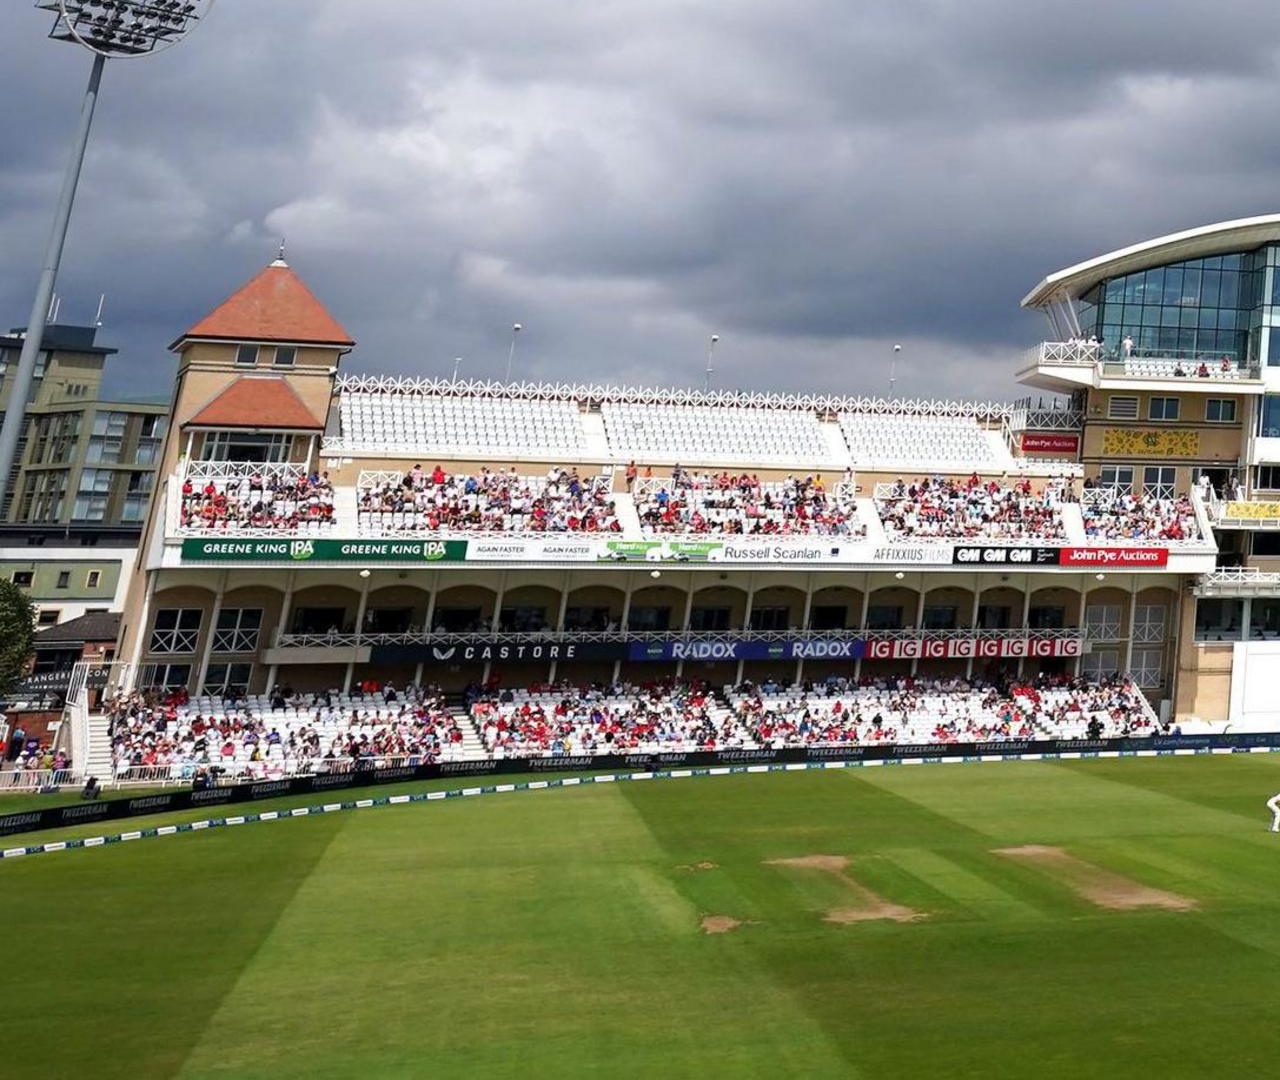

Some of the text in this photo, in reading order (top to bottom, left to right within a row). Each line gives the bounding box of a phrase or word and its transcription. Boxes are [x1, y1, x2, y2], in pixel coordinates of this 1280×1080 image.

[203, 541, 314, 554] GREENE KING IPA
[341, 542, 446, 554] GREENE KING IPA
[725, 547, 821, 559] Russell Scanlan
[957, 549, 980, 561] GM
[984, 549, 1006, 561] GM
[1009, 550, 1032, 562] GM
[1070, 550, 1159, 562] John Pye Auctions
[465, 646, 576, 659] CASTORE
[672, 642, 737, 658] RADOX
[792, 642, 851, 657] RADOX
[871, 642, 890, 658] IG
[900, 642, 916, 656] IG
[926, 641, 944, 656] IG
[954, 641, 970, 655] IG
[980, 641, 997, 656] IG
[1006, 641, 1023, 655] IG
[1033, 641, 1050, 655] IG
[1060, 640, 1078, 654] IG
[807, 748, 864, 756] TWEEZERMAN
[892, 745, 947, 753] TWEEZERMAN
[975, 742, 1028, 750] TWEEZERMAN
[528, 756, 592, 766] TWEEZERMAN
[717, 750, 777, 759] TWEEZERMAN
[440, 760, 497, 772] TWEEZERMAN
[251, 781, 290, 793] TWEEZERMAN
[191, 788, 232, 800] TWEEZERMAN
